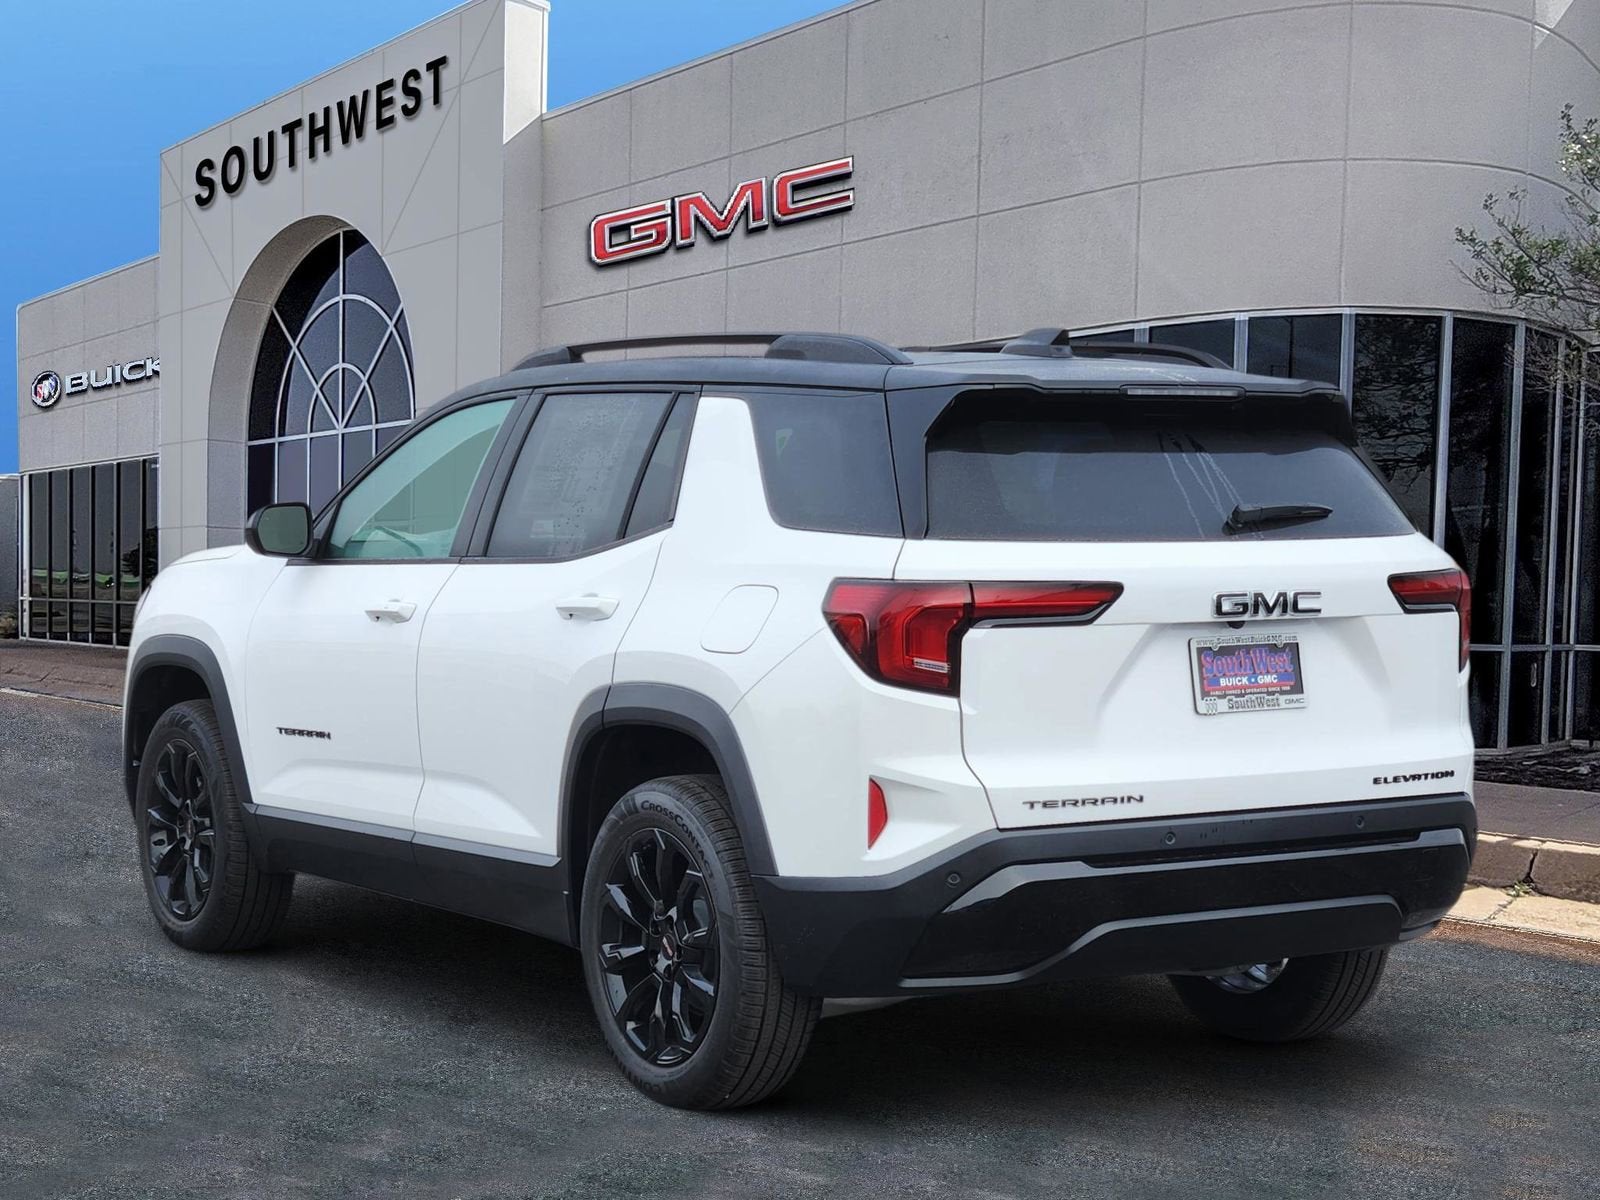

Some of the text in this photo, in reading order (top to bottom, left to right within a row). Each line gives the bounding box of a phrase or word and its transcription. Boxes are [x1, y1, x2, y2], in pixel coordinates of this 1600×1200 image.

[194, 55, 448, 208] SOUTHWEST
[589, 155, 855, 266] GMC
[64, 357, 160, 395] BUICK
[1213, 591, 1322, 617] GMC
[1220, 674, 1278, 686] BUICK GMC
[1228, 696, 1280, 710] SouthWest
[276, 726, 331, 740] TERRAIN
[1372, 770, 1454, 785] ELEVATION
[1022, 795, 1144, 810] TERRAIN
